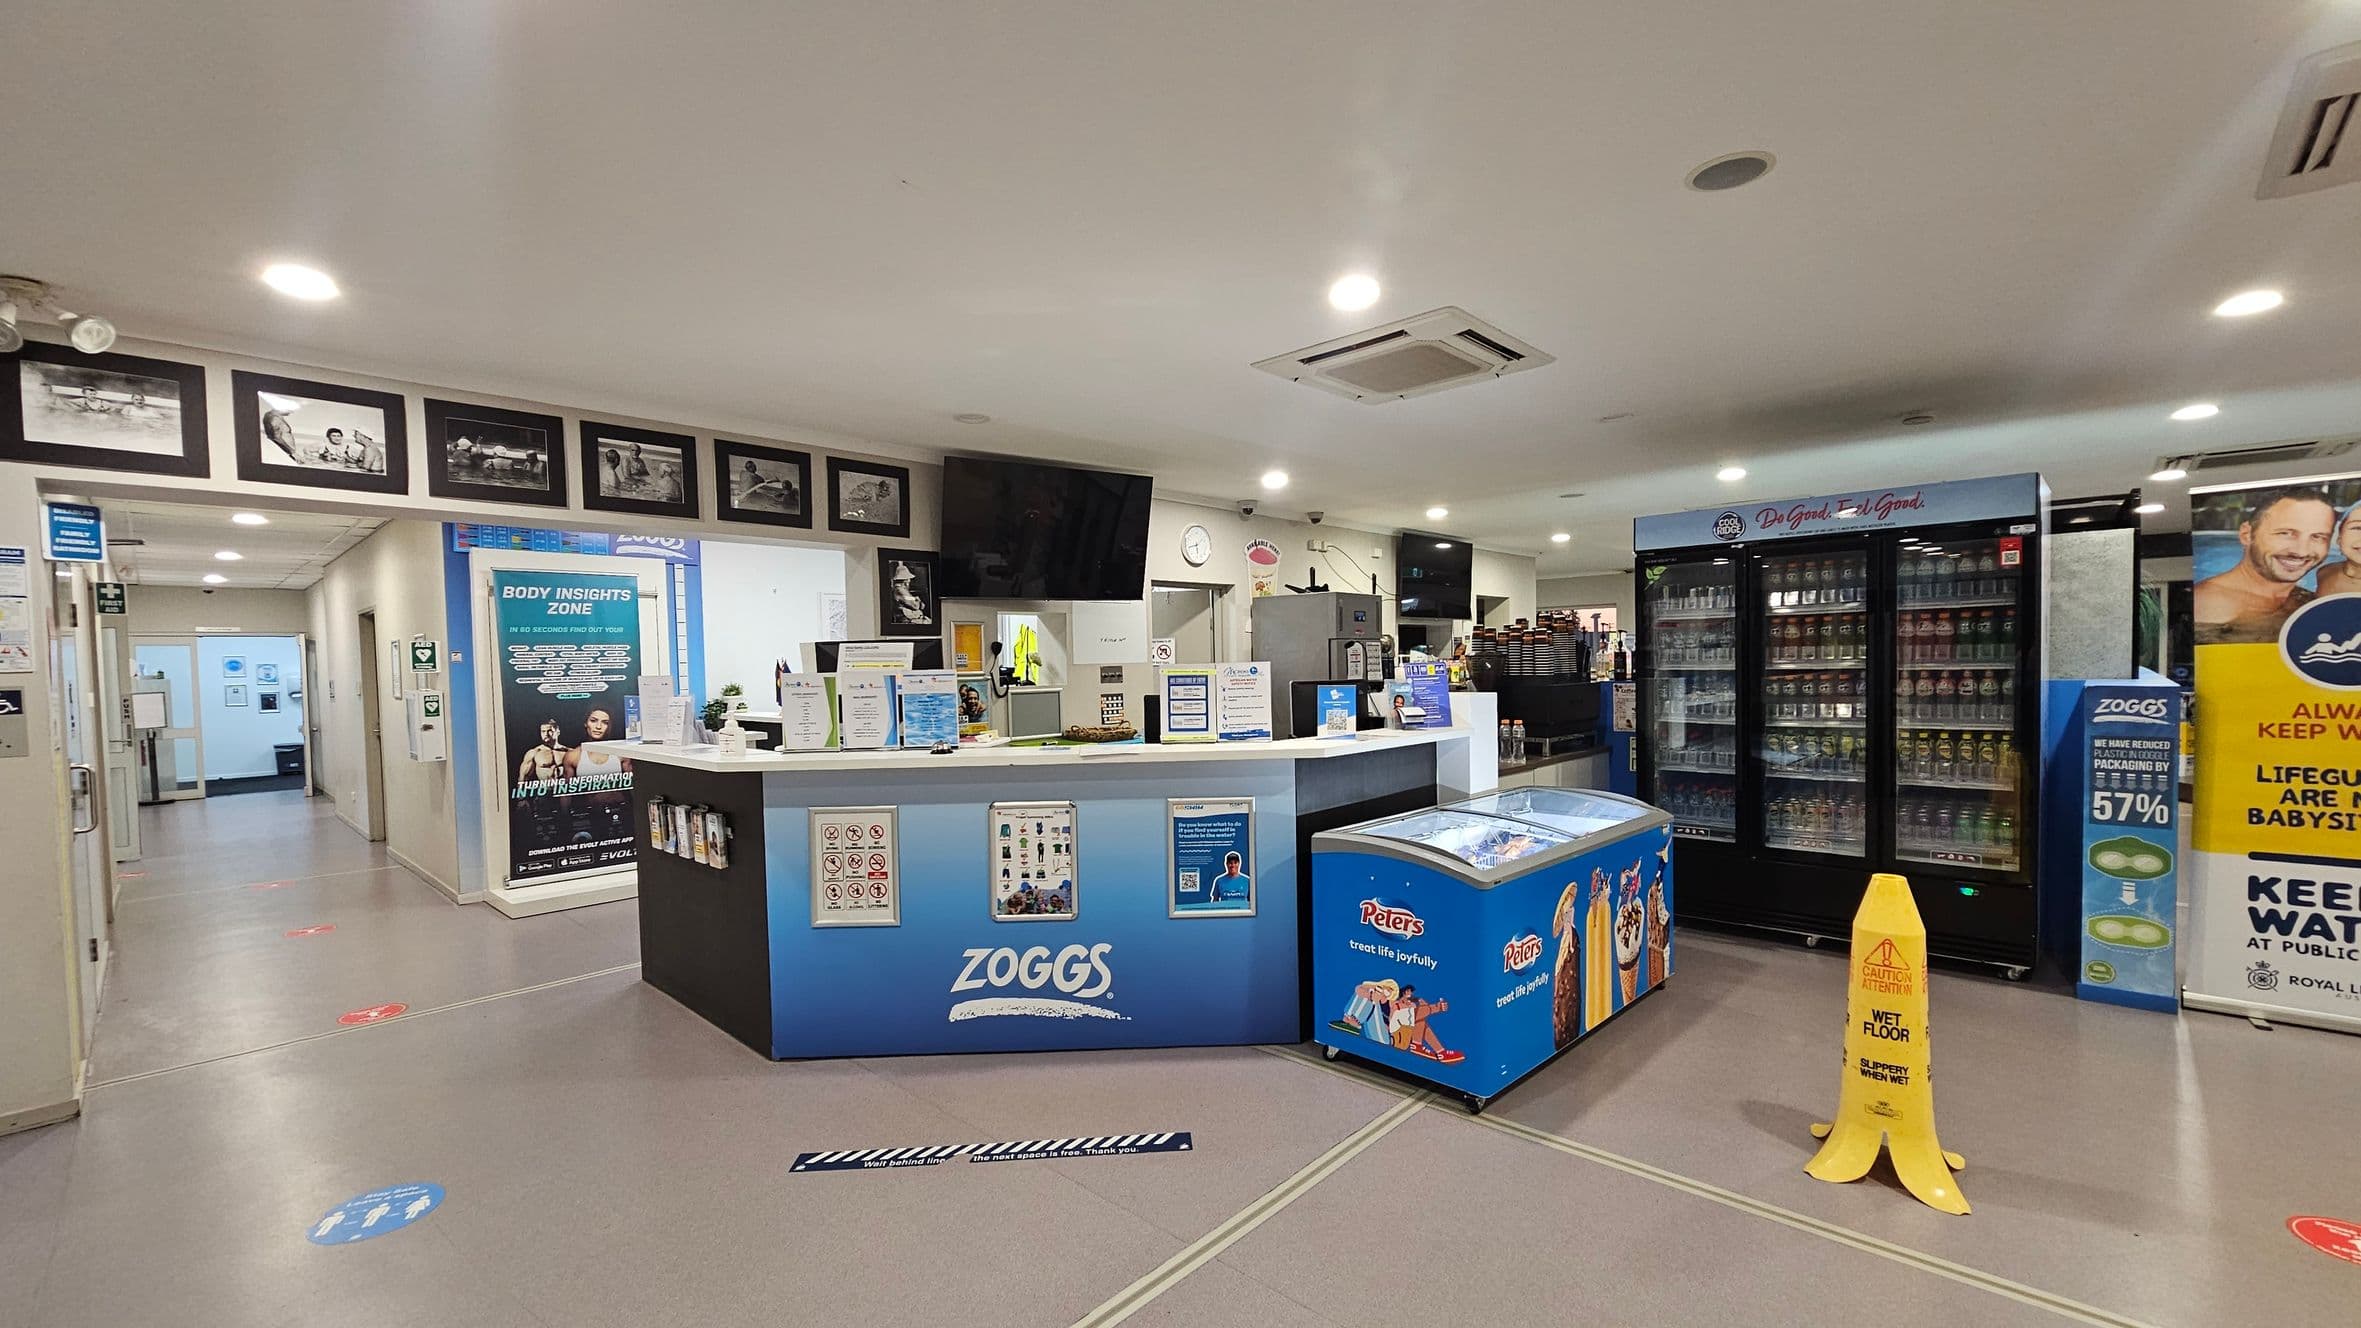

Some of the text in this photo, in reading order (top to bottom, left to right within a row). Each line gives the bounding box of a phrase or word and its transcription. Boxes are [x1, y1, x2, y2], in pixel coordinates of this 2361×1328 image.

[1755, 508, 1784, 530] Do
[1786, 502, 1832, 530] Good.
[1836, 498, 1873, 520] Fel
[1874, 491, 1925, 521] Good.
[1716, 525, 1742, 535] RIDGE
[1718, 518, 1740, 528] COOL
[502, 586, 632, 601] BODY INSIGHTS
[546, 602, 593, 615] ZONE
[2094, 698, 2168, 718] ZOGGS
[2258, 722, 2327, 740] KEEP
[2094, 739, 2170, 750] WE HAVE REDUCED
[2094, 748, 2170, 760] PLASTIC IN GOGGLE
[2094, 758, 2170, 772] PACKAGING BY
[512, 786, 548, 799] INTO
[517, 778, 566, 790] TURNING
[2092, 790, 2169, 824] 57%
[2279, 788, 2339, 808] ARE
[2248, 807, 2361, 832] BABYSI
[528, 846, 566, 856] DOWNLOAD
[2248, 875, 2361, 912] KEE
[1360, 900, 1423, 935] Peters
[1350, 939, 1438, 970] treat life joyfully
[1504, 940, 1542, 970] Peters
[2246, 937, 2360, 961] AT PUBLIC
[950, 942, 1112, 998] ZOGGS
[1862, 965, 1913, 984] CAUTION
[1496, 972, 1549, 1008] treat life joyfully
[1862, 978, 1913, 997] ATTENTION
[2289, 975, 2345, 992] ROYAL
[1872, 1008, 1902, 1026] WET
[1863, 1021, 1910, 1043] FLOOR
[1860, 1058, 1909, 1076] SLIPPERY
[1860, 1067, 1910, 1086] WHEN WET
[864, 1159, 887, 1168] Wait
[888, 1158, 924, 1167] behind
[1016, 1152, 1048, 1160] space
[1085, 1148, 1116, 1156] Thank
